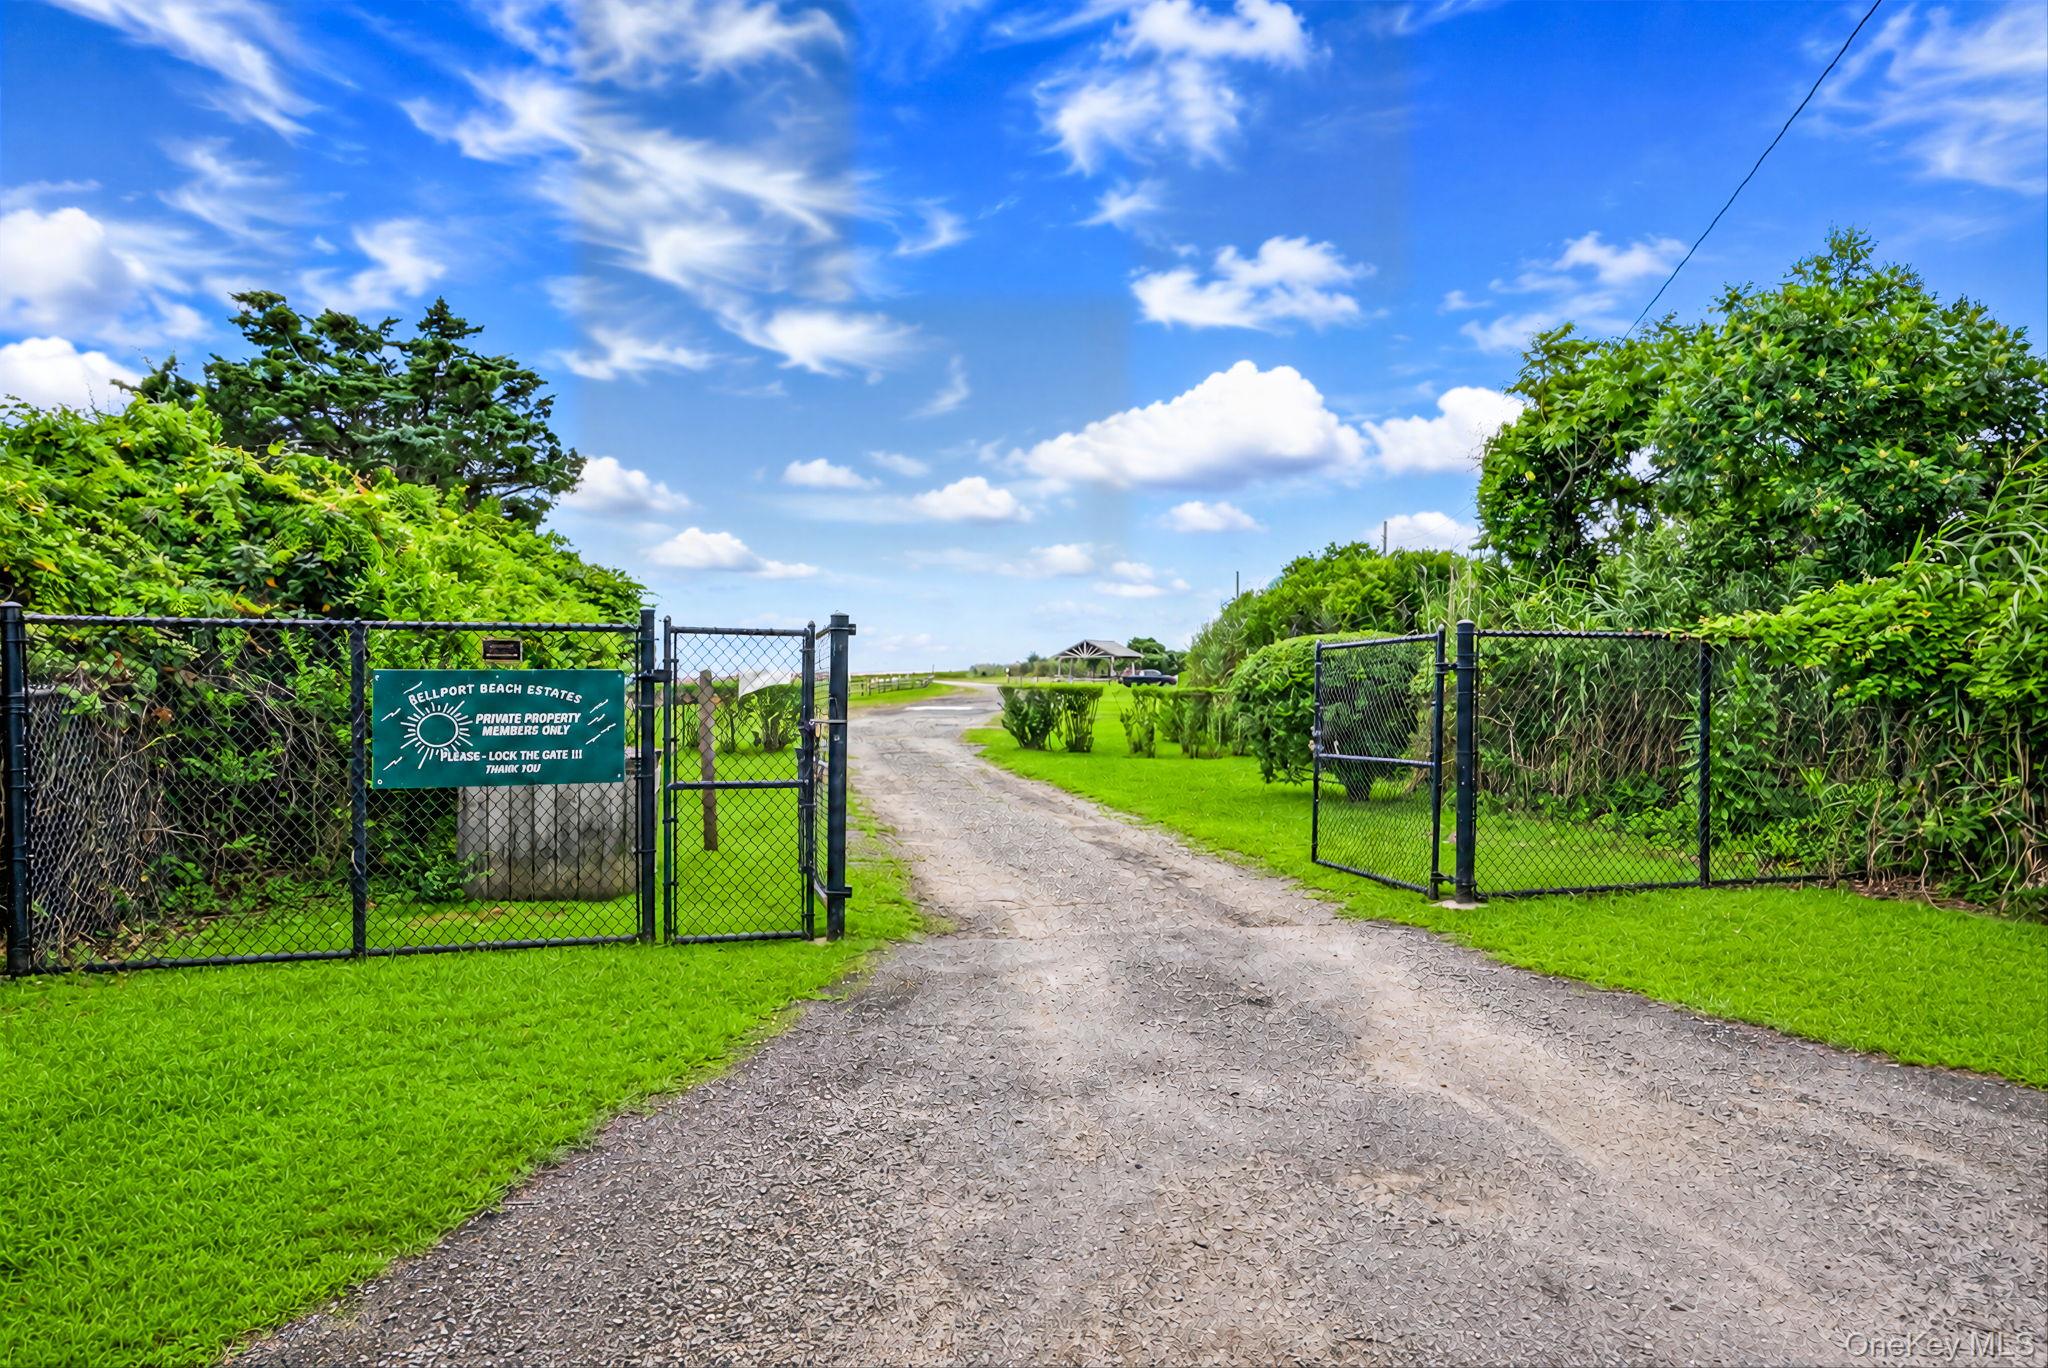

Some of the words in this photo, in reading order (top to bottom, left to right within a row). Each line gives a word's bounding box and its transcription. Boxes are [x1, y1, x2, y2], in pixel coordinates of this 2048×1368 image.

[408, 684, 475, 705] BELLPORT
[480, 683, 522, 694] BEACH
[527, 685, 583, 704] ESTATES
[475, 713, 522, 724] PRIVATE
[524, 713, 581, 724] PROPERTY
[482, 725, 539, 736] MEMBERS
[541, 725, 571, 735] ONLY
[440, 752, 480, 762] PLEASE
[488, 751, 517, 761] LOCK
[520, 750, 540, 760] THE
[541, 750, 568, 760] GATE
[485, 764, 519, 774] THANK
